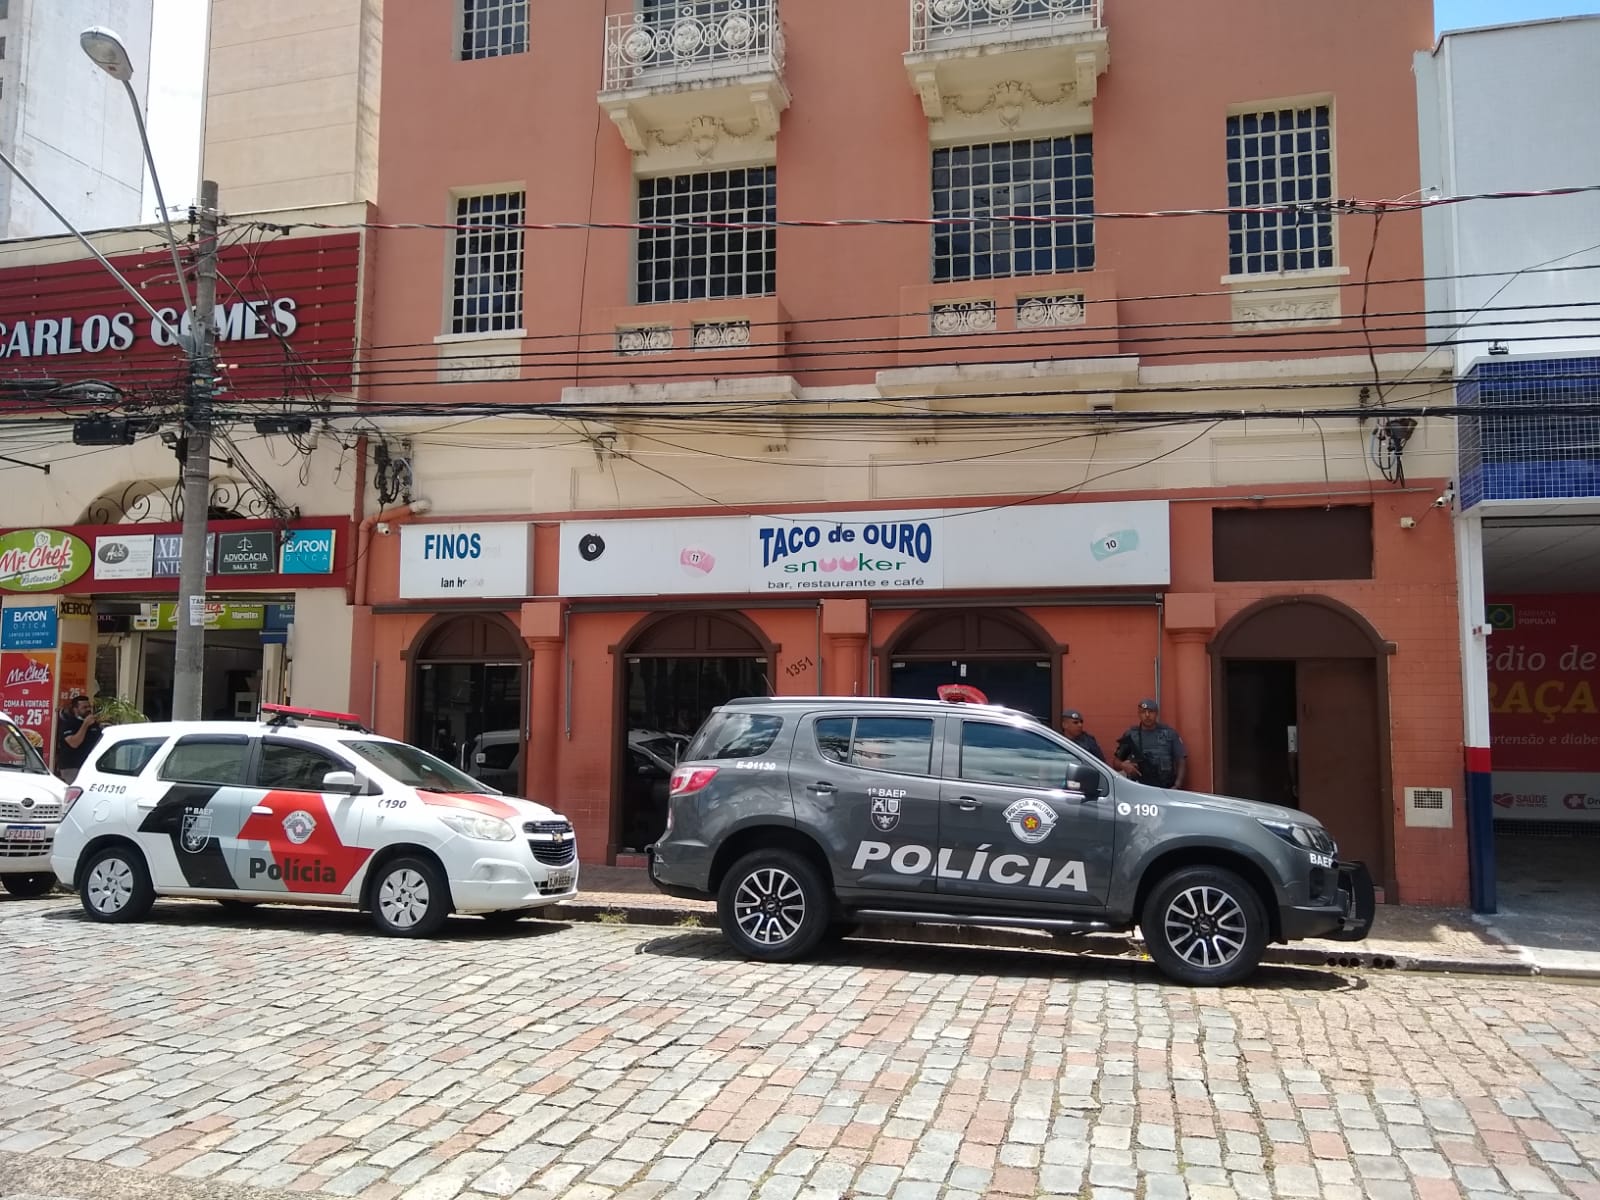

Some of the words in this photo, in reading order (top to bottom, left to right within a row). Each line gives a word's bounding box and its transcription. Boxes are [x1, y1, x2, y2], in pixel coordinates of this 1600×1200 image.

[285, 540, 329, 553] BARON
[424, 532, 481, 560] FINOS
[759, 525, 821, 569] TACO
[828, 523, 856, 543] de
[863, 522, 932, 563] OURO
[1105, 539, 1118, 550] 10
[0, 549, 26, 572] Mr.
[28, 538, 71, 573] Chef
[223, 552, 268, 562] ADVOCACIA
[691, 553, 700, 563] 11
[249, 562, 258, 570] 12
[767, 580, 793, 589] bar,
[797, 578, 876, 588] restaurante
[880, 579, 889, 587] e
[894, 577, 924, 587] café
[60, 601, 92, 616] XEROX
[13, 611, 47, 622] BARON
[1518, 617, 1557, 625] POPULAR
[1559, 644, 1597, 672] de
[785, 656, 814, 678] 1351
[6, 667, 24, 685] Mr.
[25, 663, 50, 685] Chef
[3, 700, 20, 708] COMA
[25, 700, 50, 708] VONTADE
[26, 708, 42, 726] 25
[1549, 735, 1557, 745] e
[1561, 733, 1600, 745] diabe
[735, 760, 777, 770] E-01130
[88, 783, 127, 795] E-01310
[878, 788, 907, 798] BAEP
[385, 799, 408, 809] 190
[1133, 803, 1158, 817] 190
[249, 857, 337, 885] Polícia
[851, 839, 1089, 893] POLÍCIA
